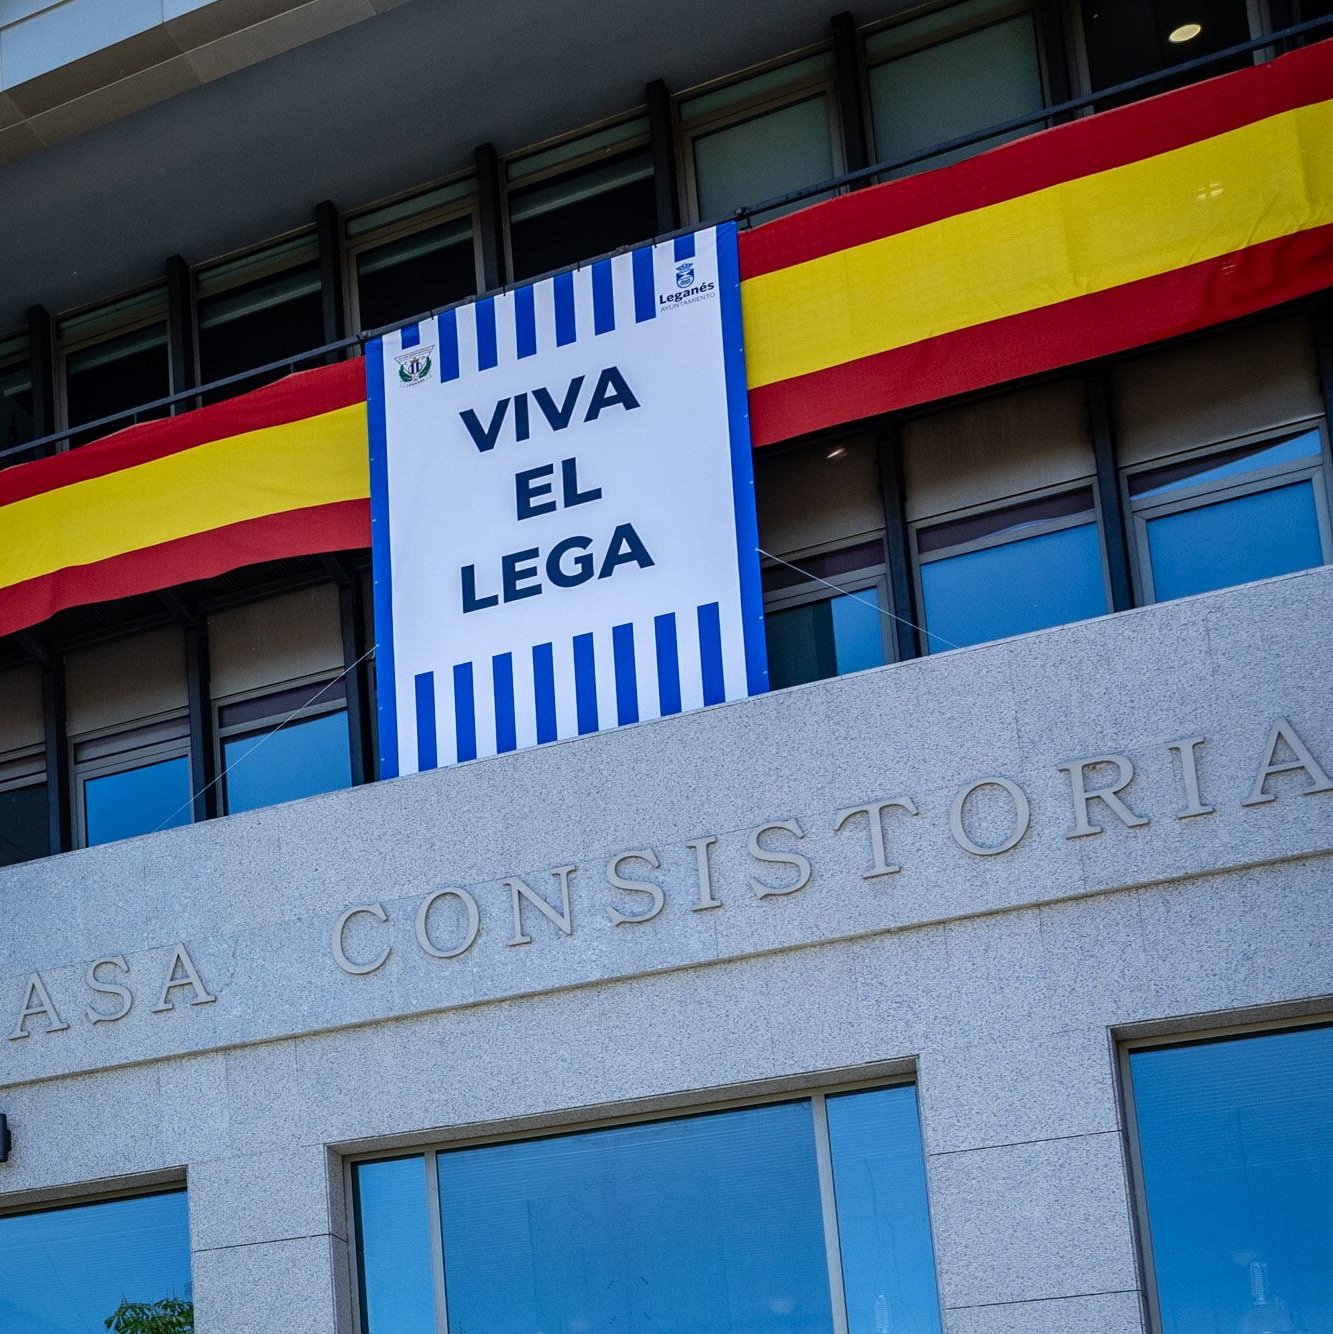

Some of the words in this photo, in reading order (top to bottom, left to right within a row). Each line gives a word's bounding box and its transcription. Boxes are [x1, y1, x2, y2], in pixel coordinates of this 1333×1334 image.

[659, 281, 715, 305] Leganés
[660, 291, 716, 313] AYUNTAMIENTO
[459, 365, 641, 453] VIVA
[514, 456, 603, 521] EL
[460, 522, 655, 614] LEGA
[332, 715, 1333, 976] CONSISTORIA
